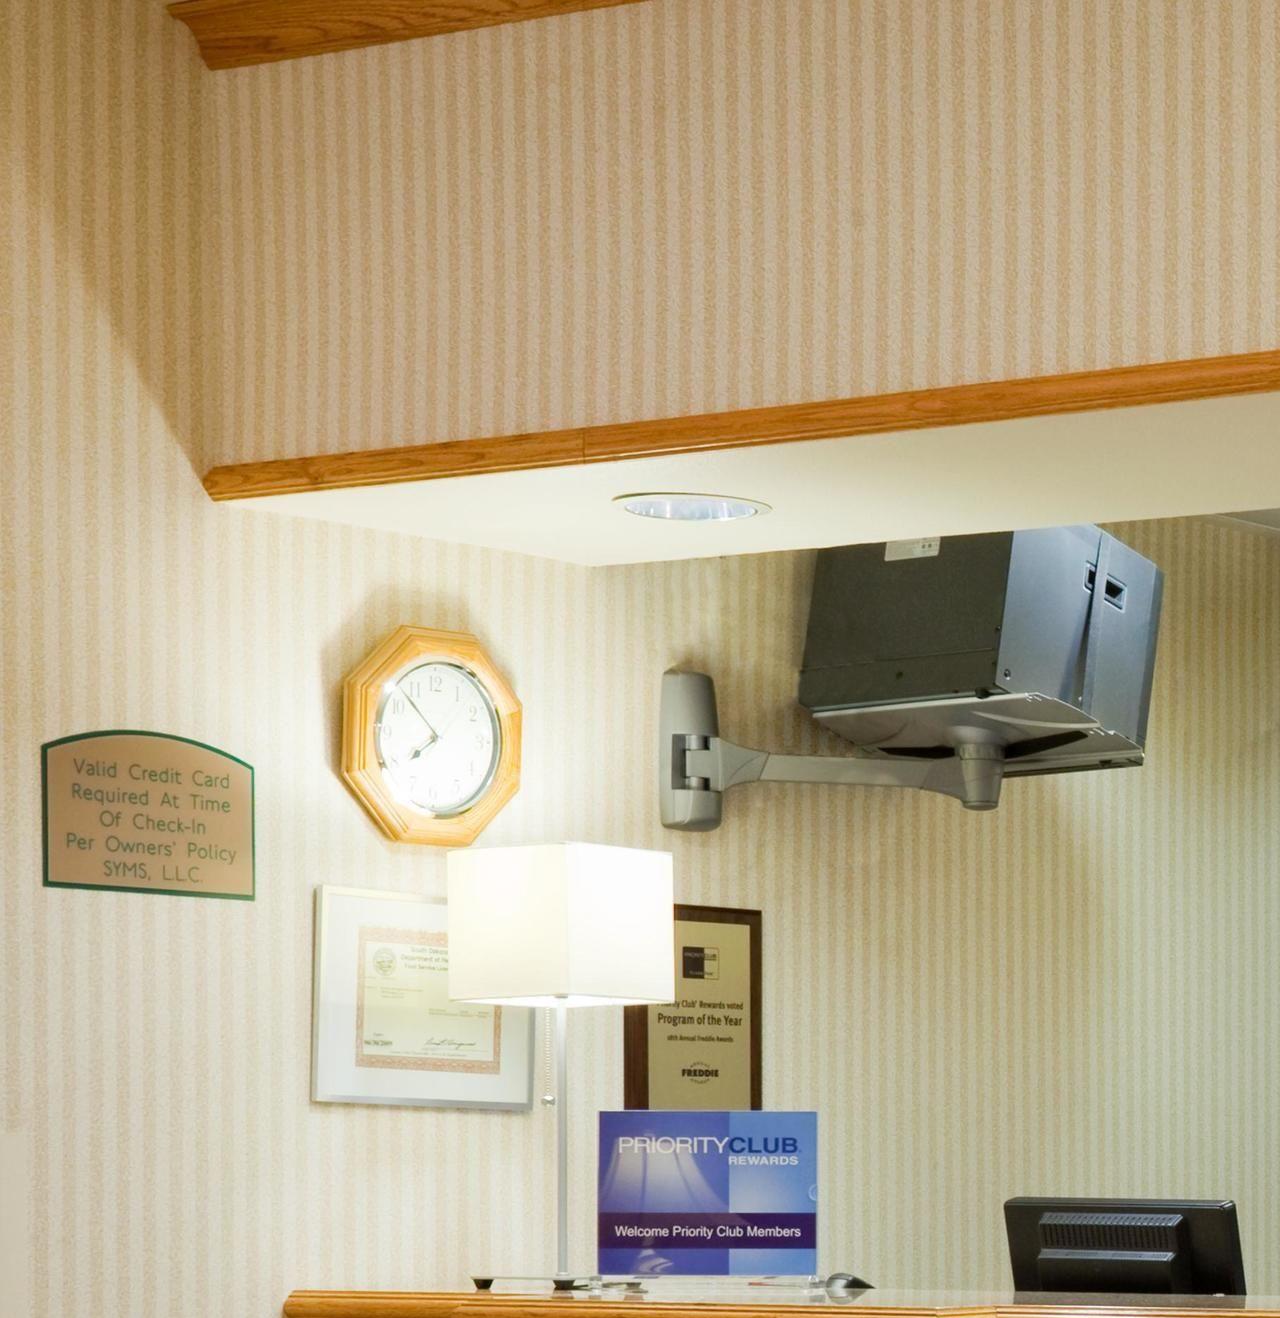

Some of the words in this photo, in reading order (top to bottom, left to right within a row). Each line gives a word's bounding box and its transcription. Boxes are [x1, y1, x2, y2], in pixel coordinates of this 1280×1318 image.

[429, 675, 442, 692] 12
[468, 705, 478, 722] 2
[73, 758, 117, 778] Valid
[128, 763, 182, 785] Credit
[191, 770, 230, 789] Card
[71, 783, 149, 806] Required
[160, 792, 180, 809] At
[191, 793, 231, 813] Time
[100, 810, 122, 828] Of
[132, 813, 206, 835] Check-In
[66, 832, 94, 850] Per
[105, 835, 177, 857] Owners'
[187, 842, 237, 865] Policy
[103, 860, 151, 880] SYMS,
[657, 1012, 695, 1027] Program
[696, 1014, 707, 1025] of
[707, 1015, 722, 1026] the
[723, 1015, 743, 1026] Year
[681, 1068, 719, 1078] FREDDIE
[728, 1156, 799, 1165] REWARDS
[615, 1225, 669, 1237] Welcome
[672, 1225, 713, 1240] Priority
[716, 1225, 743, 1237] Club
[747, 1226, 801, 1238] Members
